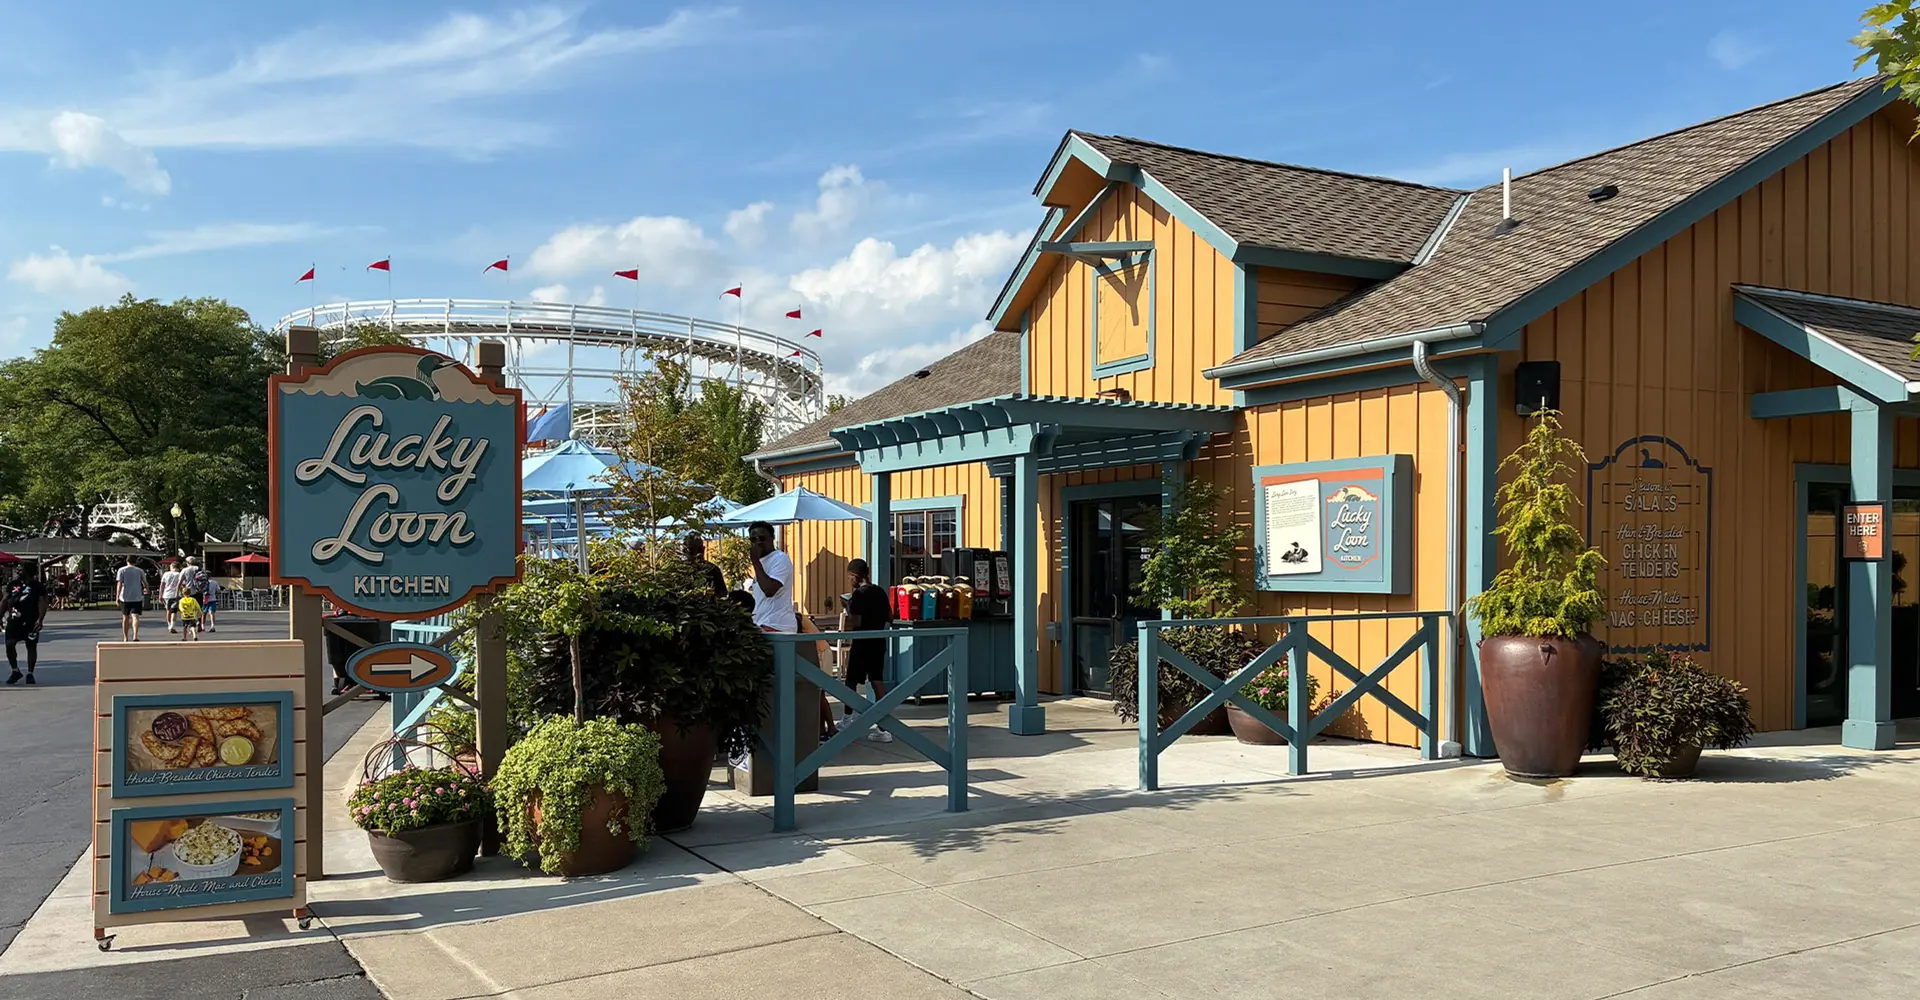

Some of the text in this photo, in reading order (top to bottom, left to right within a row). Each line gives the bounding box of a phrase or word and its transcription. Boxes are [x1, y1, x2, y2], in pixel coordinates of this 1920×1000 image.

[295, 405, 489, 502] Lucky
[311, 483, 475, 564] Loon
[1331, 504, 1372, 533] Lucky
[1847, 513, 1879, 523] ENTER
[1333, 527, 1369, 552] Loon
[1850, 525, 1877, 535] HERE
[1623, 543, 1678, 560] CHICKEN
[1621, 561, 1679, 578] TENDERS
[353, 575, 450, 595] KITCHEN
[125, 766, 280, 785] Hand-Breaded Chicken Tenders
[130, 875, 283, 899] House-Made Mac and Cheese
